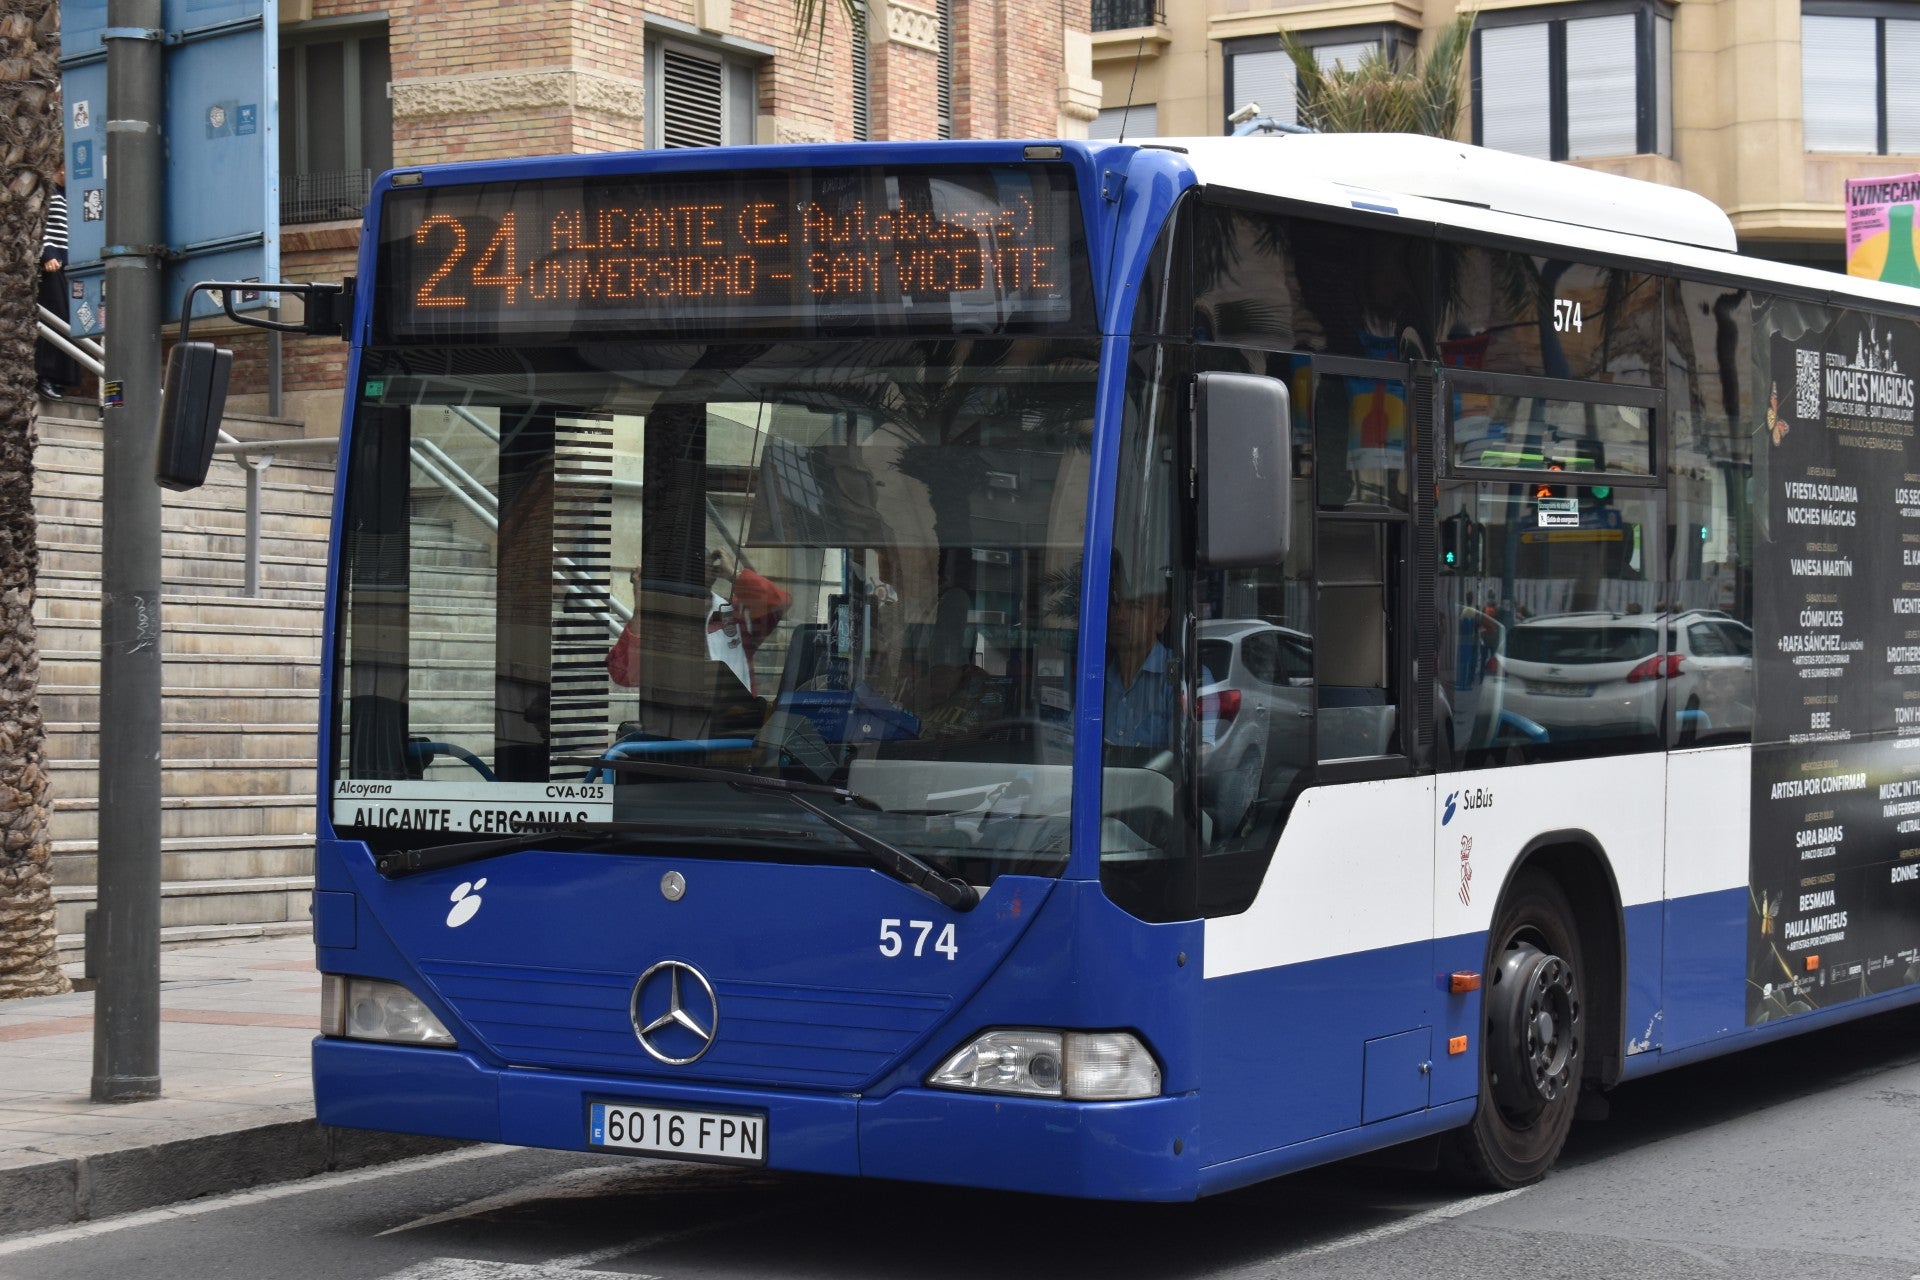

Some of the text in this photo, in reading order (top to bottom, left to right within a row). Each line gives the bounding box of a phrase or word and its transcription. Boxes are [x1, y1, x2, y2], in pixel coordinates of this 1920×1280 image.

[553, 205, 723, 250] ALICANTE
[738, 203, 788, 244] (E.
[416, 212, 523, 306] 24
[529, 254, 756, 299] UNIVERSIDAD
[807, 251, 879, 293] SAN
[895, 246, 1055, 291] VICENTE
[1553, 298, 1583, 333] 574
[1826, 368, 1914, 408] NOCHES MAGICAS
[1785, 481, 1858, 503] V FIESTA SOLIDARIA
[1895, 488, 1908, 505] LOS
[1787, 504, 1856, 527] NOCHES MÁGICAS
[1790, 556, 1853, 577] VANESA MARTÍN
[1903, 549, 1911, 566] EL
[1800, 606, 1844, 628] CÓMPLICES
[1804, 630, 1841, 652] SÁNCHEZ
[1811, 711, 1831, 729] BEBE
[1894, 707, 1914, 723] TONY
[338, 780, 605, 799] Alcoyana CVA-025
[1770, 772, 1867, 800] ARTISTA POR CONFIRMAR
[1879, 782, 1903, 800] MUSIC
[1903, 781, 1911, 797] IN
[1463, 787, 1494, 810] SuBús
[1883, 801, 1898, 818] IVÁN
[353, 807, 451, 832] ALICANTE
[1796, 825, 1843, 848] SARA BARAS
[1891, 863, 1919, 883] BONNIE
[1799, 889, 1836, 912] BESMAYA
[1785, 911, 1848, 939] PAULA MATHEUS
[879, 918, 959, 961] 574
[594, 1128, 602, 1138] E
[608, 1109, 758, 1155] 6016 FPN
